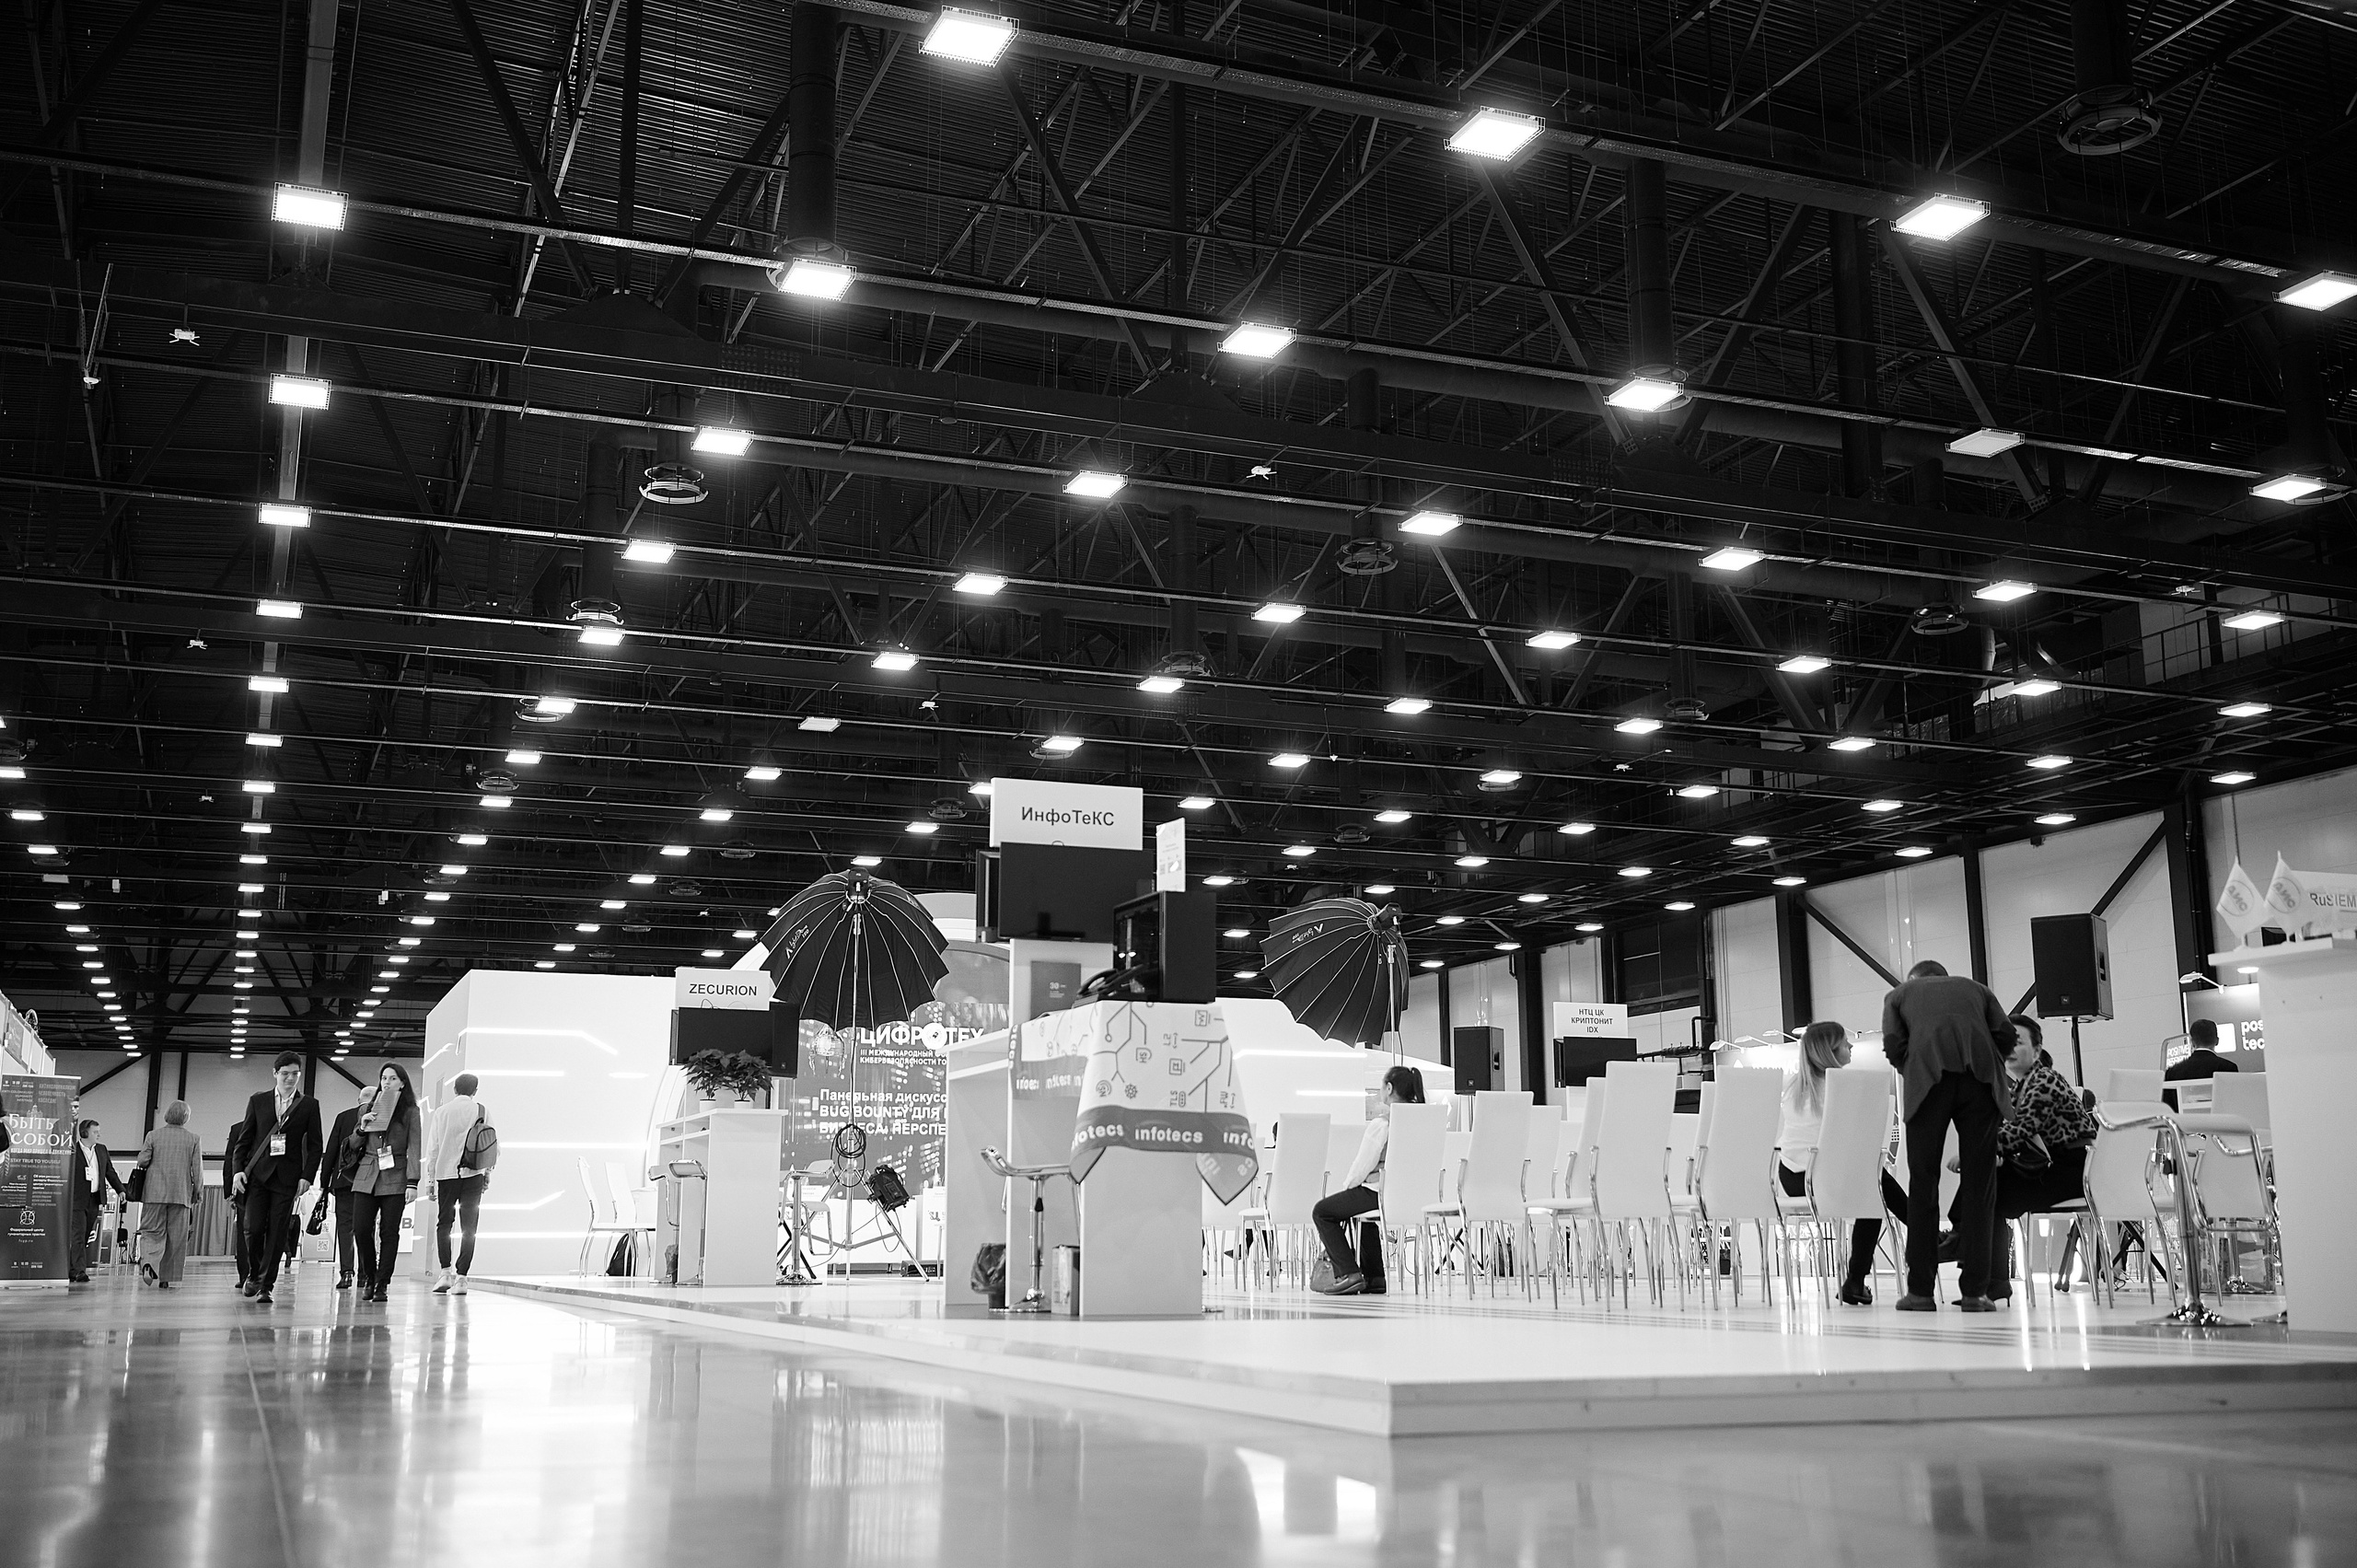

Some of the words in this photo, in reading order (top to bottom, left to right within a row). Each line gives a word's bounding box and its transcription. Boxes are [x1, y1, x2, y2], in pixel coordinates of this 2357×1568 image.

[1021, 806, 1114, 826] ИнфоТеКС
[2309, 892, 2357, 908] RuSIEM
[689, 983, 757, 995] ZECURION
[1578, 1008, 1594, 1016] НТЦ
[1571, 1016, 1613, 1025] КРИПТОНИТ
[2240, 1019, 2264, 1037] pos
[2242, 1036, 2265, 1051] tec
[819, 1088, 893, 1102] Панельная
[1169, 1090, 1178, 1106] TLS
[819, 1105, 850, 1118] BUG
[853, 1105, 910, 1119] BOUNTY
[911, 1107, 940, 1121] ДЛЯ
[8, 1113, 54, 1131] БЫТЬ
[10, 1131, 73, 1147] СОБОЙ
[1135, 1125, 1203, 1144] infotecs
[401, 1217, 414, 1229] B
